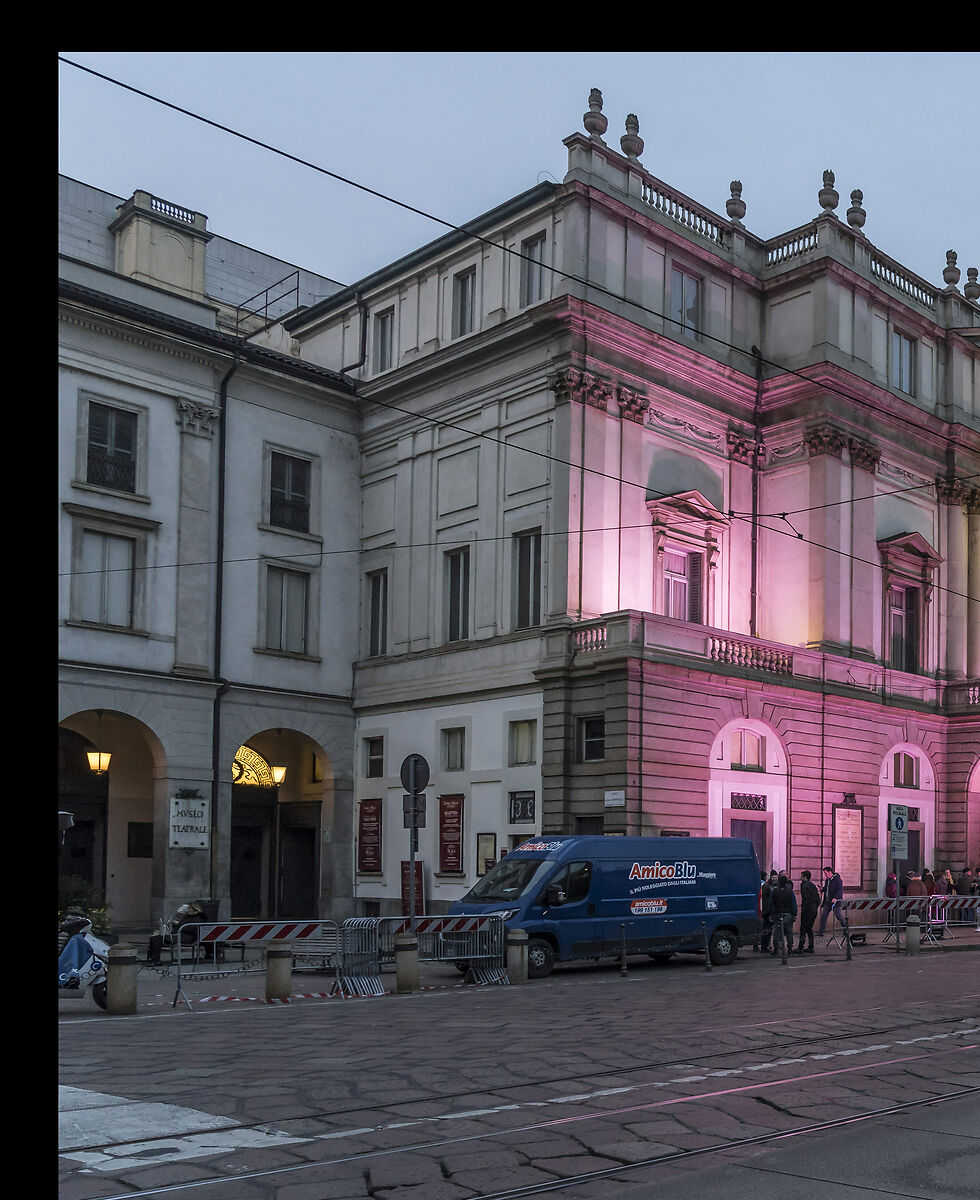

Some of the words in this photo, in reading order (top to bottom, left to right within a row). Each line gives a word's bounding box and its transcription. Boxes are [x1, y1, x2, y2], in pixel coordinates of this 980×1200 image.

[172, 824, 208, 834] TEATRALE
[629, 861, 697, 880] AmicoBlu
[642, 881, 668, 892] NOLEGGIATO
